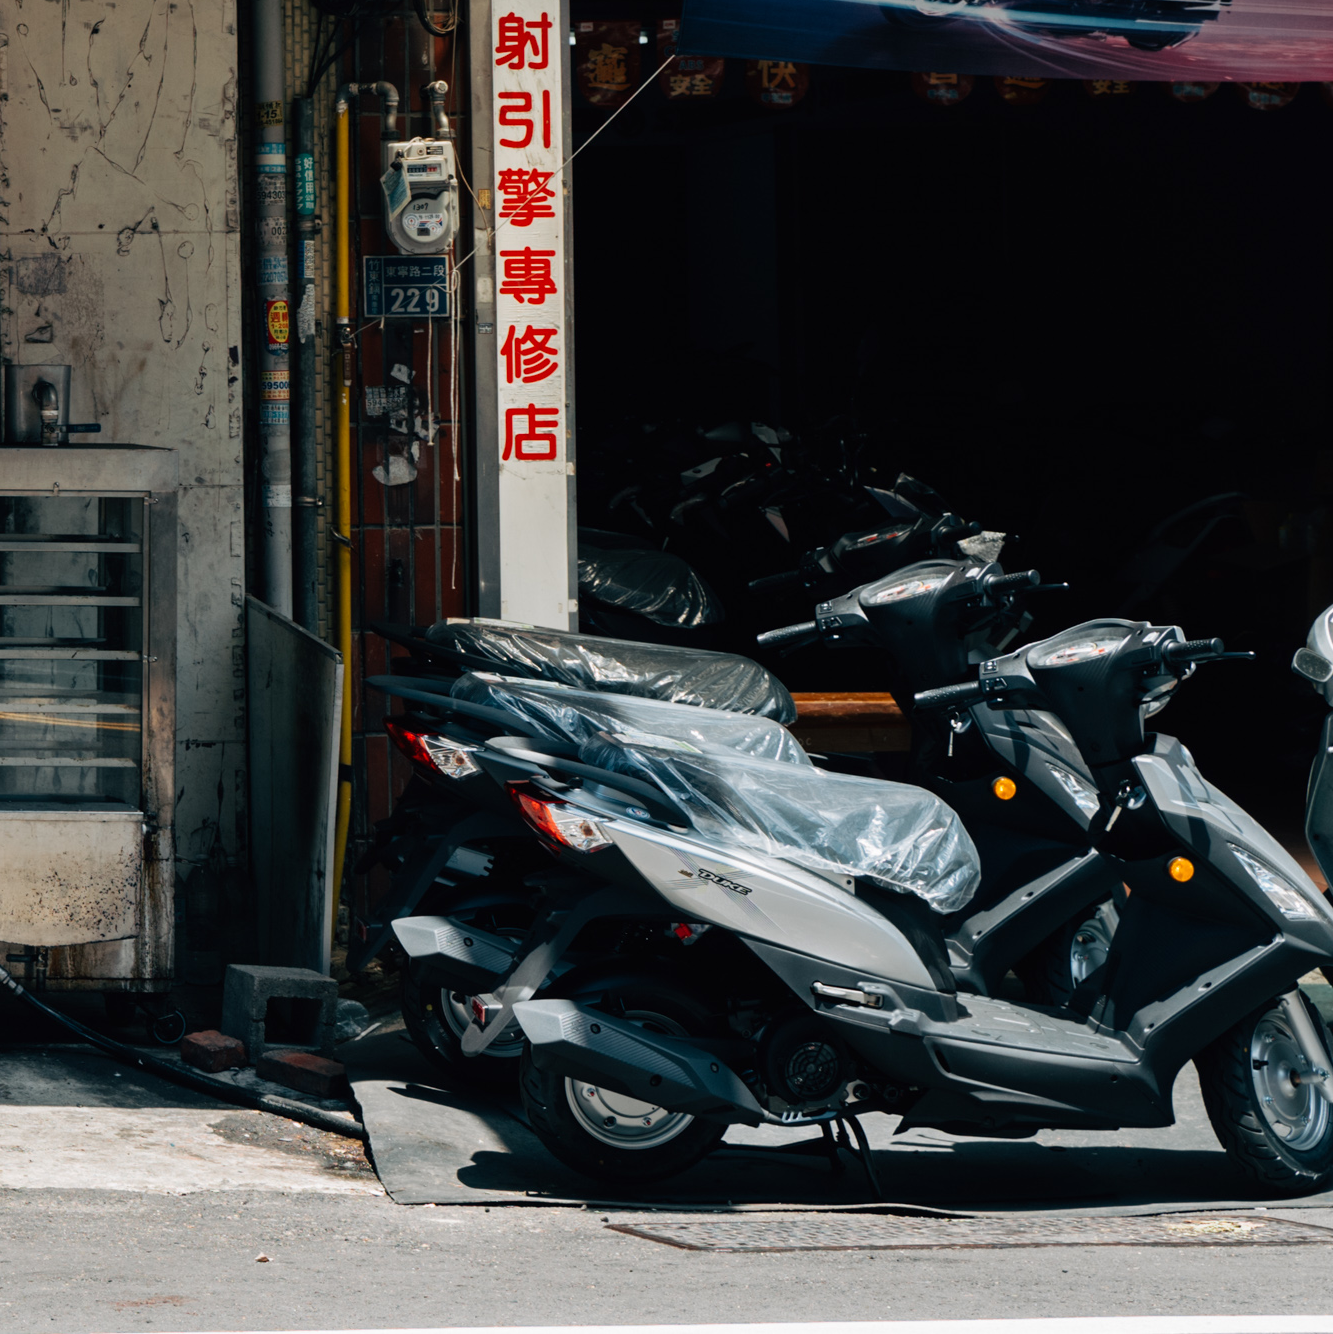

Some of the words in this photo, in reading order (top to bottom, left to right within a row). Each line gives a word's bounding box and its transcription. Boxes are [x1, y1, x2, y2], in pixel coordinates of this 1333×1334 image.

[669, 74, 713, 98] 安全
[368, 259, 381, 294] 竹東鎮
[385, 264, 446, 278] 東寧路二段
[390, 287, 440, 313] 229
[698, 868, 752, 897] DUKE
